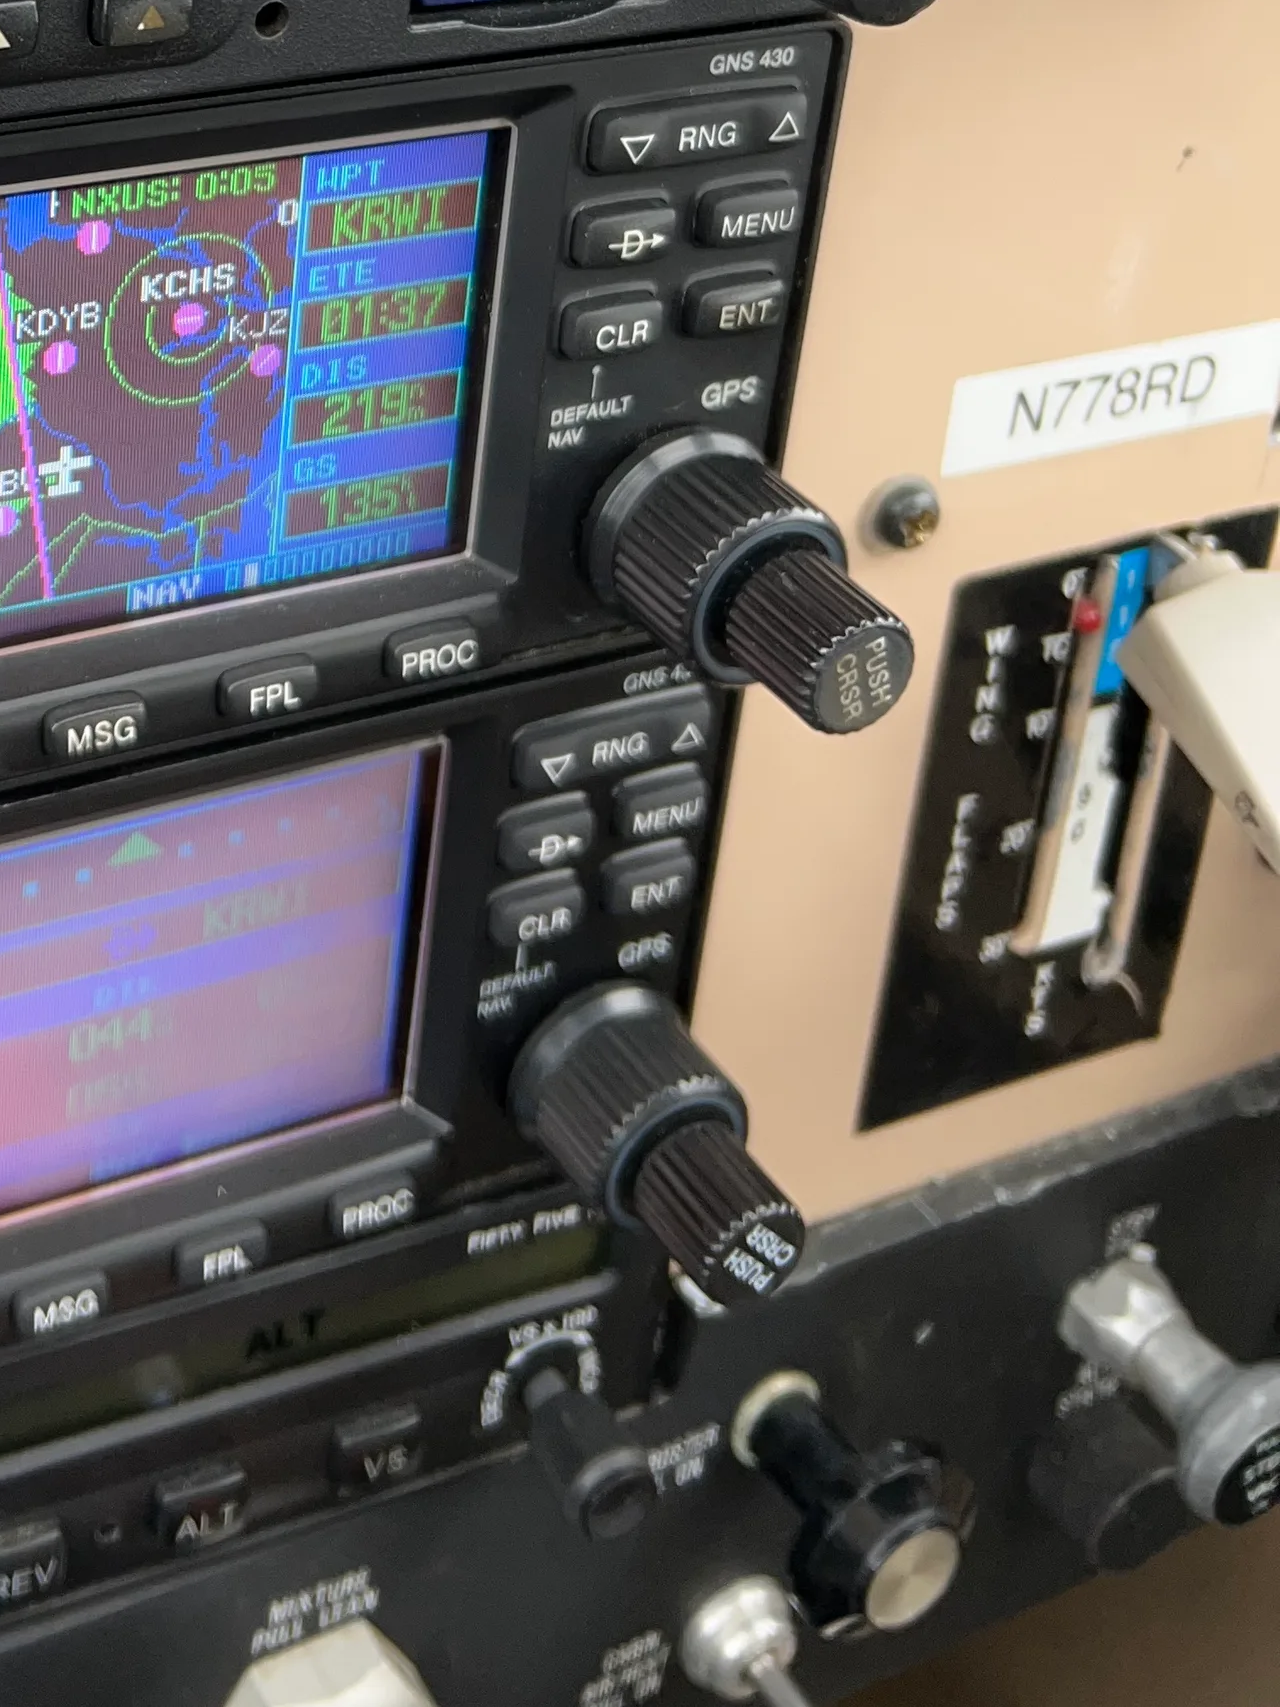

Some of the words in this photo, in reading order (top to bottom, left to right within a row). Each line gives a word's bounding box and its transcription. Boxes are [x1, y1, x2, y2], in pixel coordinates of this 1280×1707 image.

[709, 52, 754, 76] GNS
[759, 47, 795, 68] 430
[679, 122, 737, 152] RNG
[316, 159, 385, 194] WPT
[332, 186, 447, 247] KRWI
[721, 207, 796, 239] MENU
[141, 262, 236, 303] KCHS
[308, 256, 377, 293] ETE
[17, 301, 102, 340] KDYB
[720, 298, 773, 330] ENT
[596, 320, 649, 352] CLR
[300, 354, 367, 390] DIS
[701, 376, 759, 408] GPS
[1008, 356, 1218, 436] N778RD
[550, 395, 633, 427] DEFAULT
[548, 427, 583, 449] NAV
[400, 641, 479, 677] PROC
[864, 636, 893, 709] PUSH
[249, 682, 300, 714] FPL
[835, 652, 863, 722] CRSR
[67, 716, 138, 754] MSG
[592, 730, 651, 765] RNG
[633, 797, 701, 835] MENU
[632, 875, 683, 911] ENT
[520, 907, 572, 941] CLR
[341, 1187, 415, 1235] PROC
[32, 1288, 101, 1334] MSG
